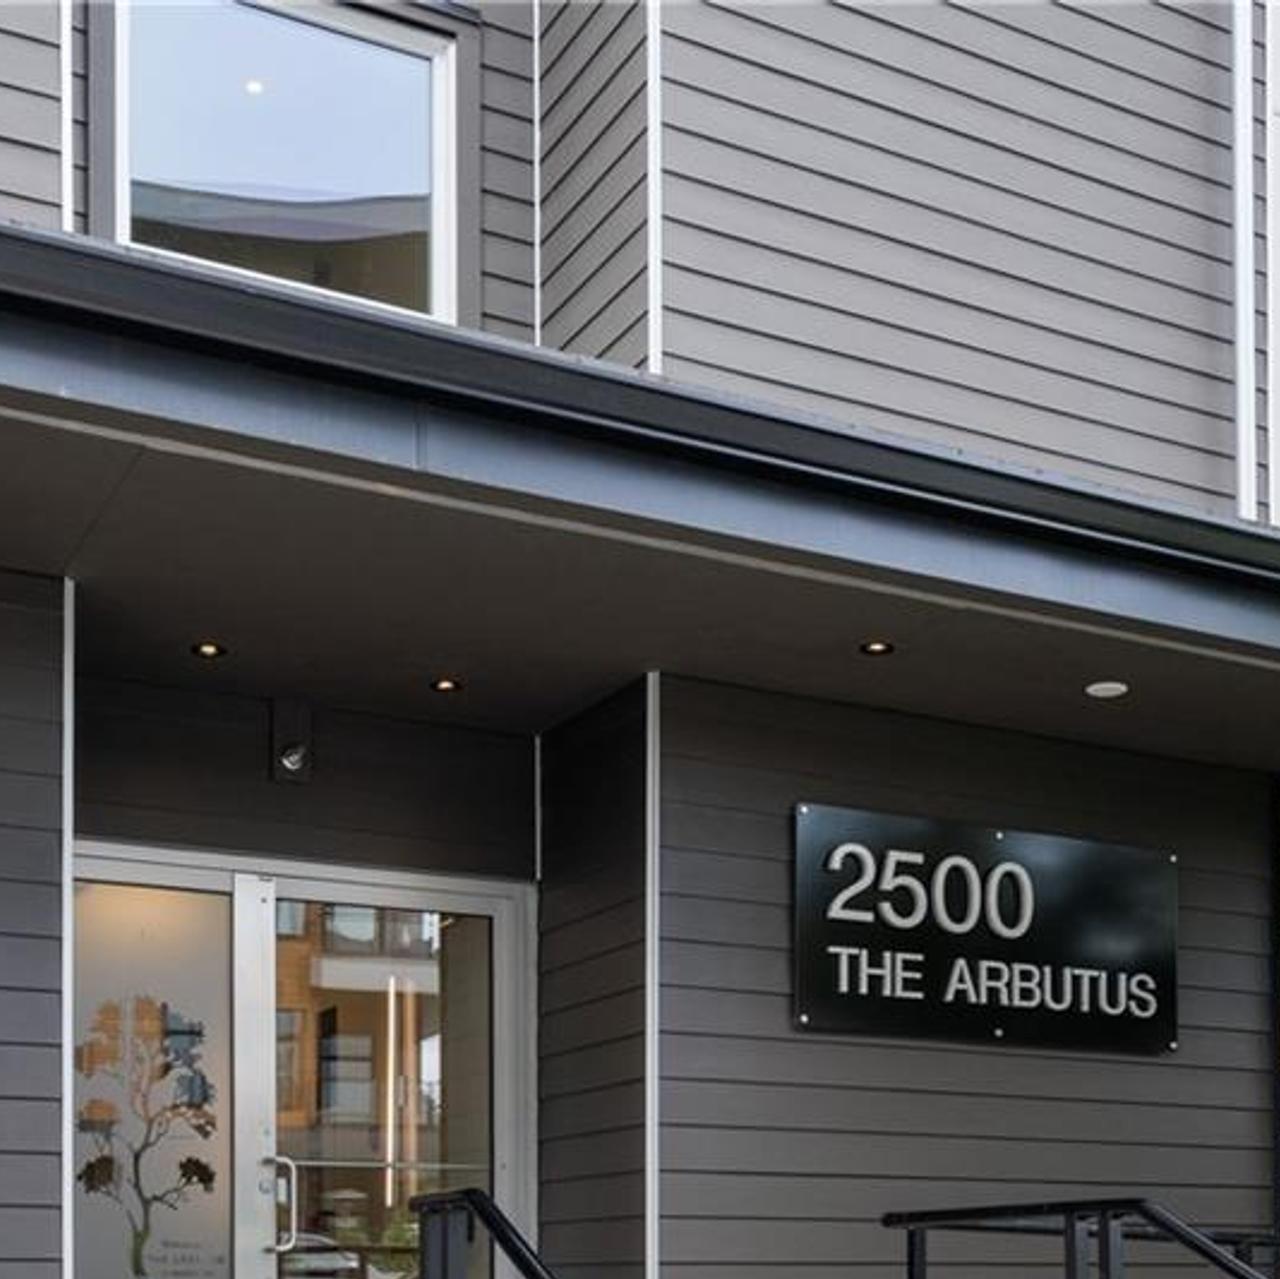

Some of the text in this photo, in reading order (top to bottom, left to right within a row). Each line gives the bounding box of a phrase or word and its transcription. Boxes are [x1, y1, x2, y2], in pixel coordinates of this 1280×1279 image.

[826, 842, 1034, 939] 2500
[826, 946, 1158, 1018] THE ARBUTUS
